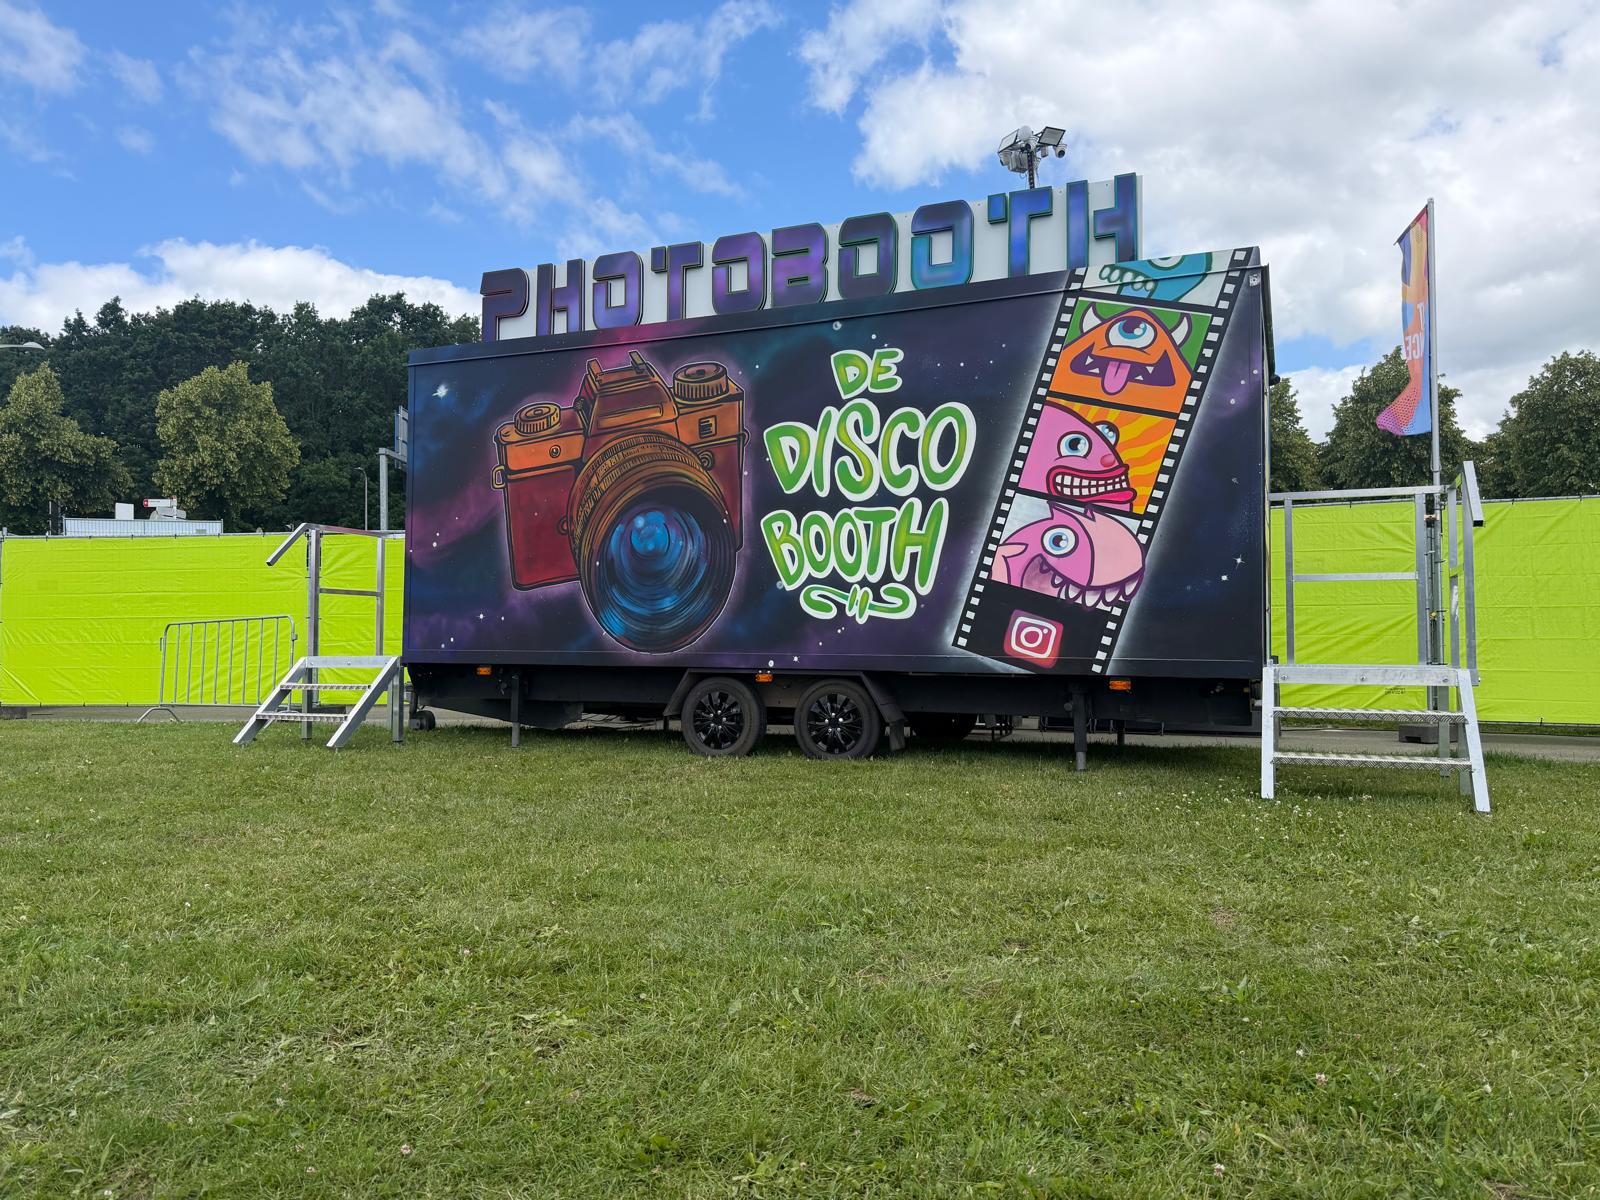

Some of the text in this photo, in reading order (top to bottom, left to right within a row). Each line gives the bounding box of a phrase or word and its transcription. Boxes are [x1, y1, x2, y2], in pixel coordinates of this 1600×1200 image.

[481, 172, 1138, 342] PHOTOBOOTH
[831, 348, 904, 399] DE
[764, 398, 976, 501] DISCO
[760, 497, 949, 595] BOOTH
